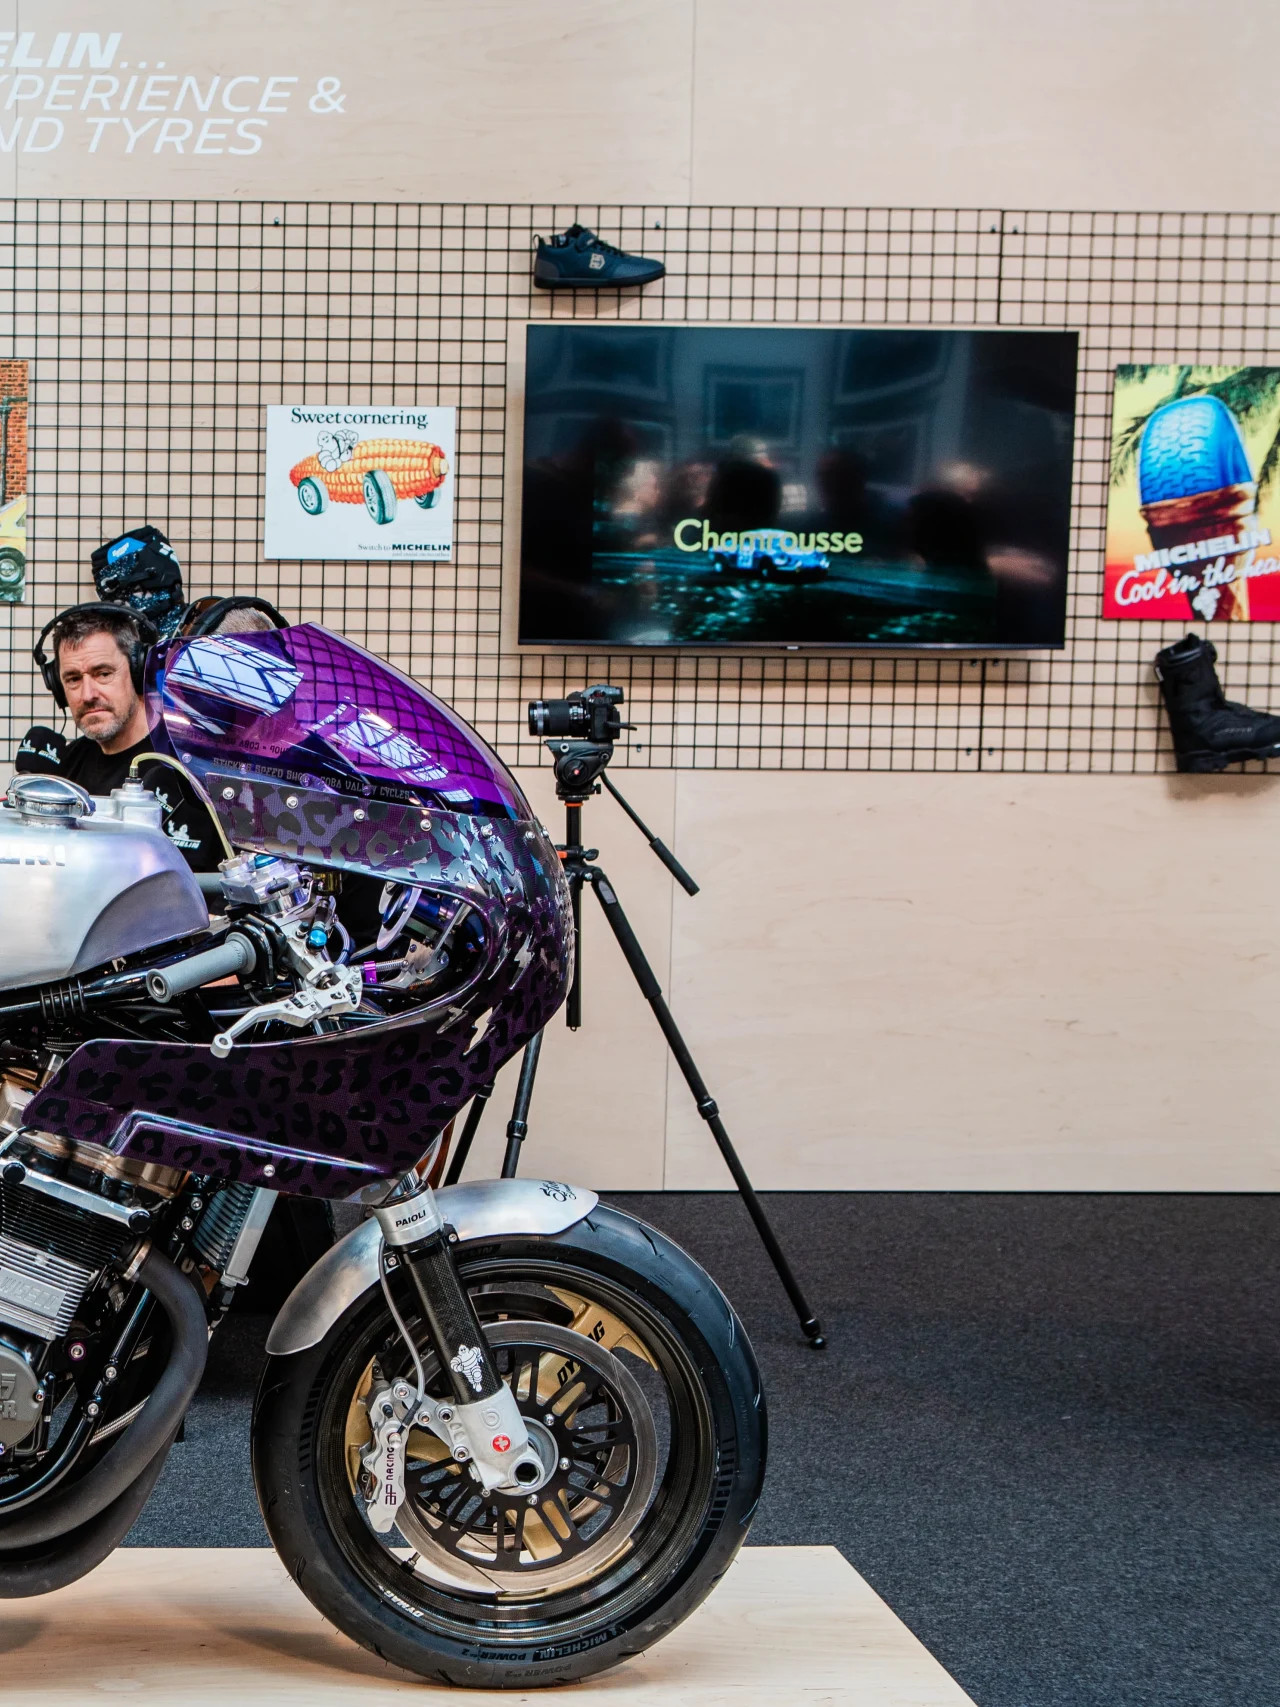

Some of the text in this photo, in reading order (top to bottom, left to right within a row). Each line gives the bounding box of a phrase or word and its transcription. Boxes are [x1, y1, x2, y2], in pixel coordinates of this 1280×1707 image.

[308, 77, 347, 114] &
[84, 118, 265, 156] TYRES
[291, 407, 429, 430] Sweet cornering.
[673, 518, 864, 554] Chamrousse
[1133, 529, 1272, 573] MICHELIN
[1114, 549, 1280, 606] Cool in the hea
[255, 764, 283, 779] SPEED
[380, 786, 410, 800] CYCLES
[395, 1209, 426, 1228] PAIOLI
[386, 1446, 395, 1481] RACING
[384, 1588, 424, 1618] DYMAG
[479, 1651, 527, 1661] POWER
[539, 1633, 608, 1660] MICHELIN
